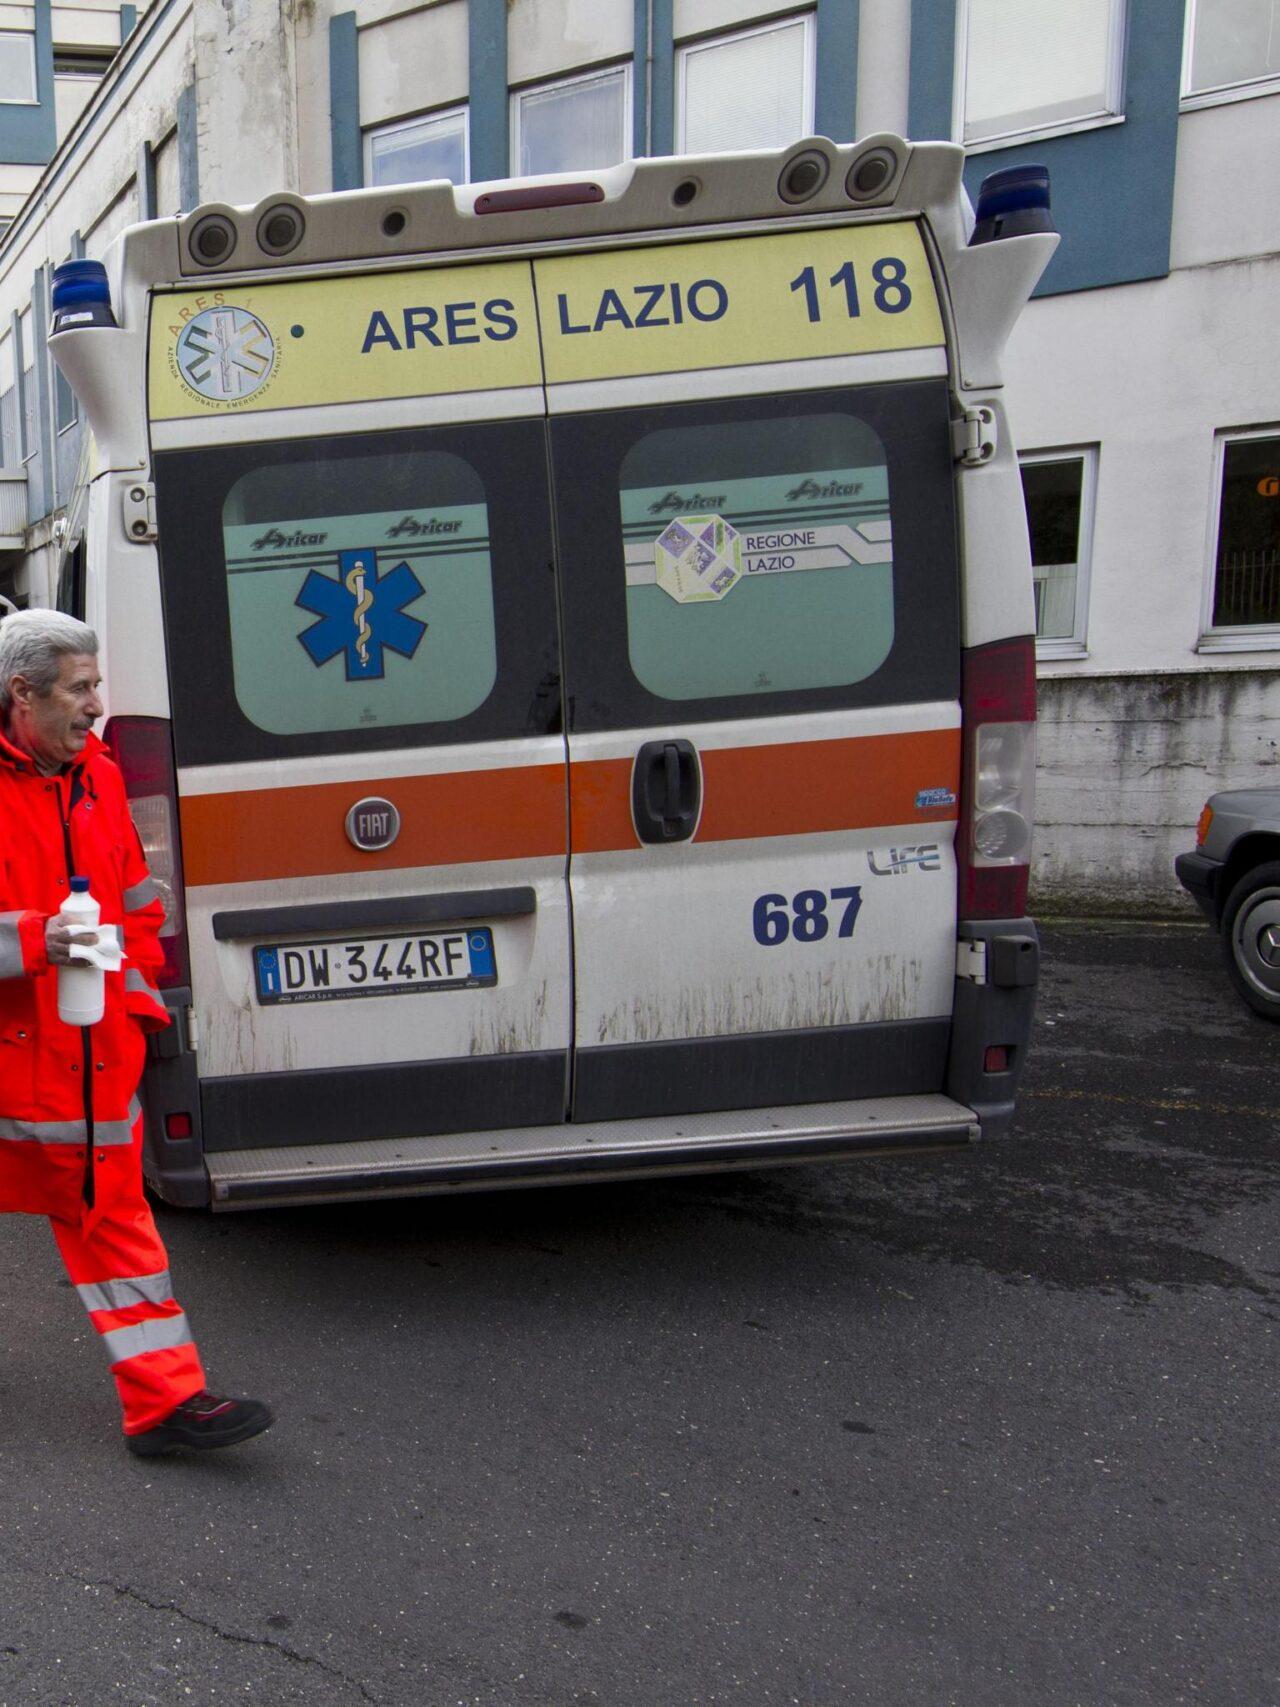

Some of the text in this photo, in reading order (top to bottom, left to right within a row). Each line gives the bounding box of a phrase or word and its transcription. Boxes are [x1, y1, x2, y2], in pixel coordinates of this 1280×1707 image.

[168, 292, 225, 337] ARES
[361, 257, 912, 354] ARES LAZIO 118
[180, 384, 221, 408] REGIONALE
[227, 383, 271, 408] EMERGENZA
[747, 531, 816, 551] REGIONE
[748, 556, 795, 573] LAZIO
[359, 812, 389, 838] FIAT
[867, 844, 941, 876] LIFE
[753, 886, 863, 947] 687
[284, 949, 330, 989] DW
[345, 937, 464, 984] 344RF
